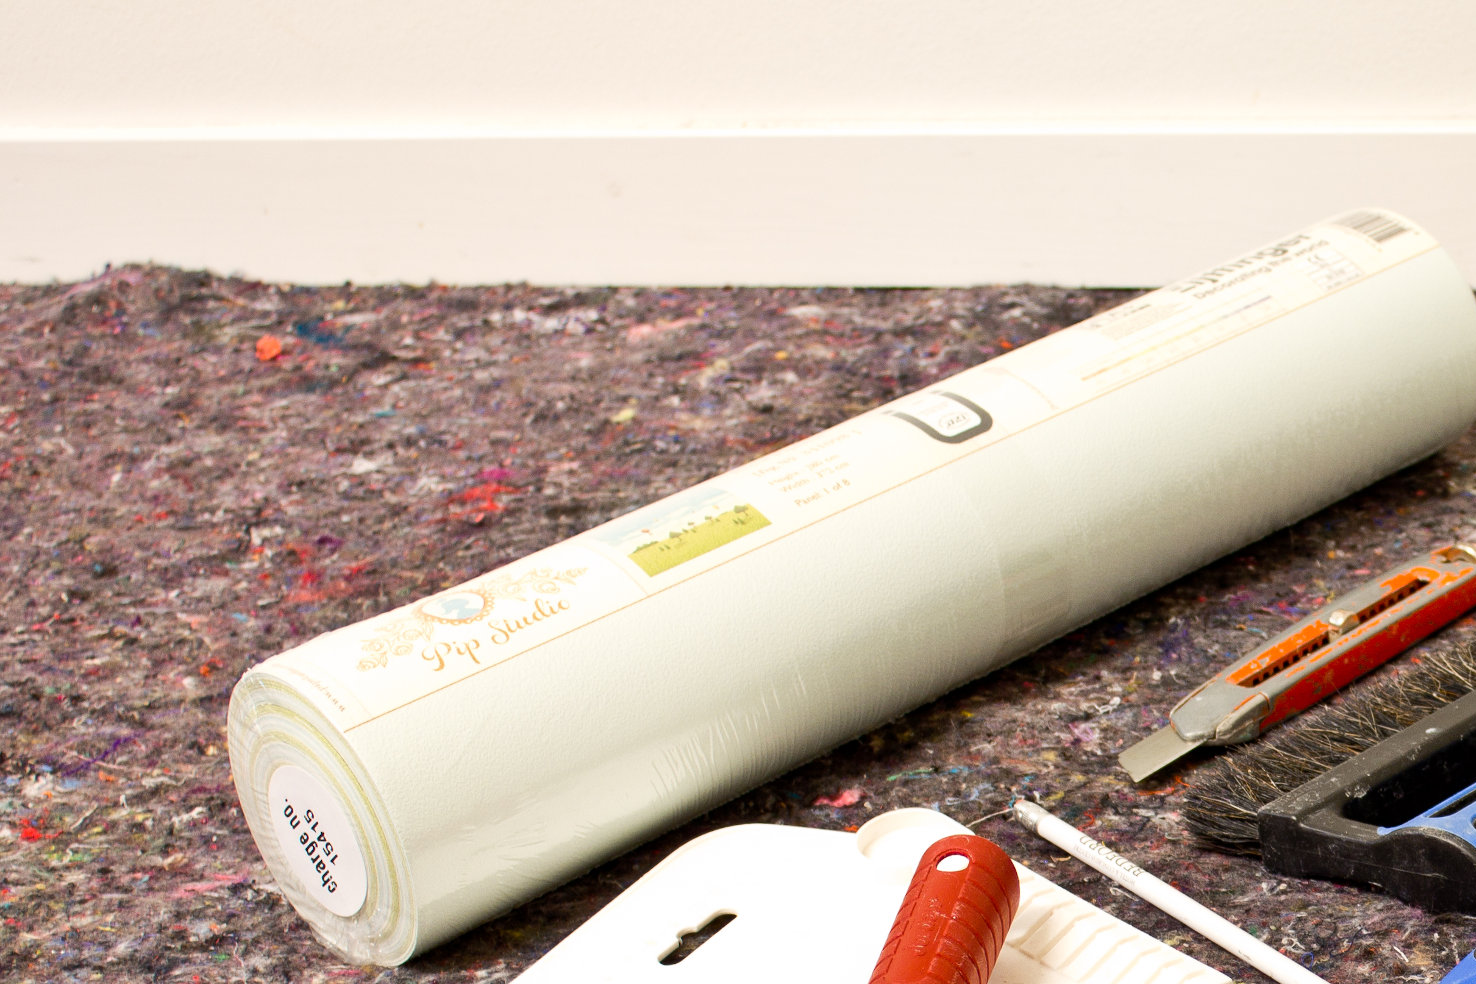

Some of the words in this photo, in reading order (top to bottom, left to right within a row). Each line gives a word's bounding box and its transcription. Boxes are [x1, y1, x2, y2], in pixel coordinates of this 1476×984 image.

[421, 639, 481, 672] Pip
[488, 598, 570, 645] Studio
[284, 798, 301, 830] no.
[303, 809, 339, 866] 15415
[299, 832, 338, 893] charge
